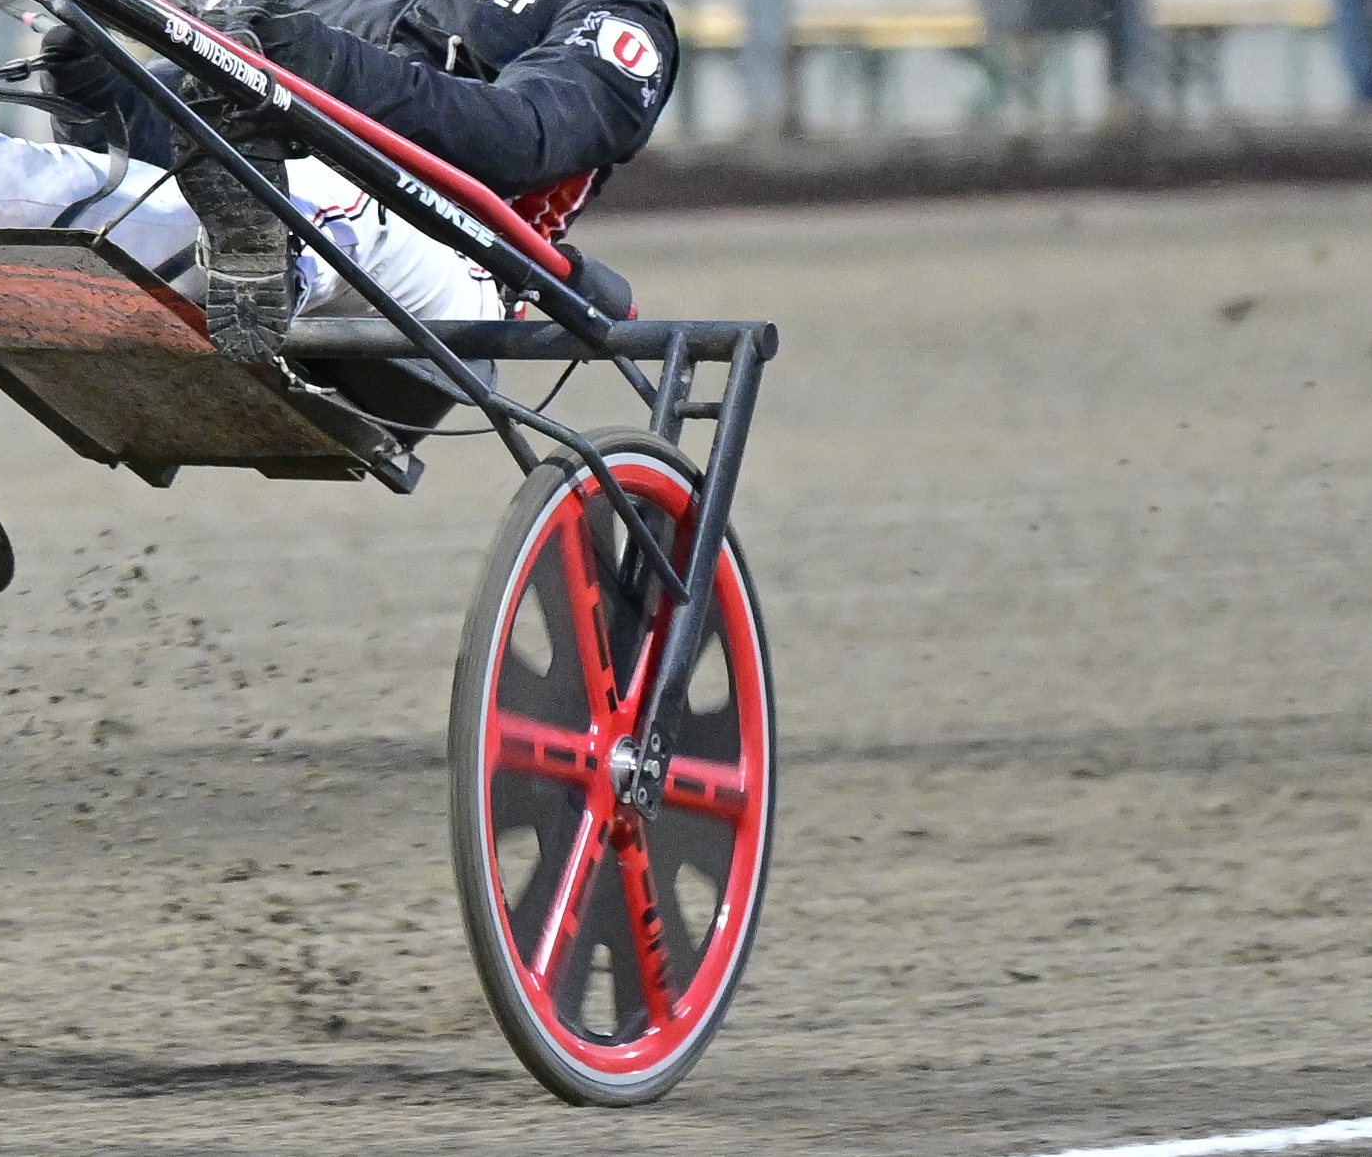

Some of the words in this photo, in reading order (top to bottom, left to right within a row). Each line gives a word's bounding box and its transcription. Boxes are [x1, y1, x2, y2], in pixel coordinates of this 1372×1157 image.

[192, 30, 292, 112] UNTERSTEINER.OM
[613, 31, 650, 69] U
[396, 170, 496, 248] YANKEE
